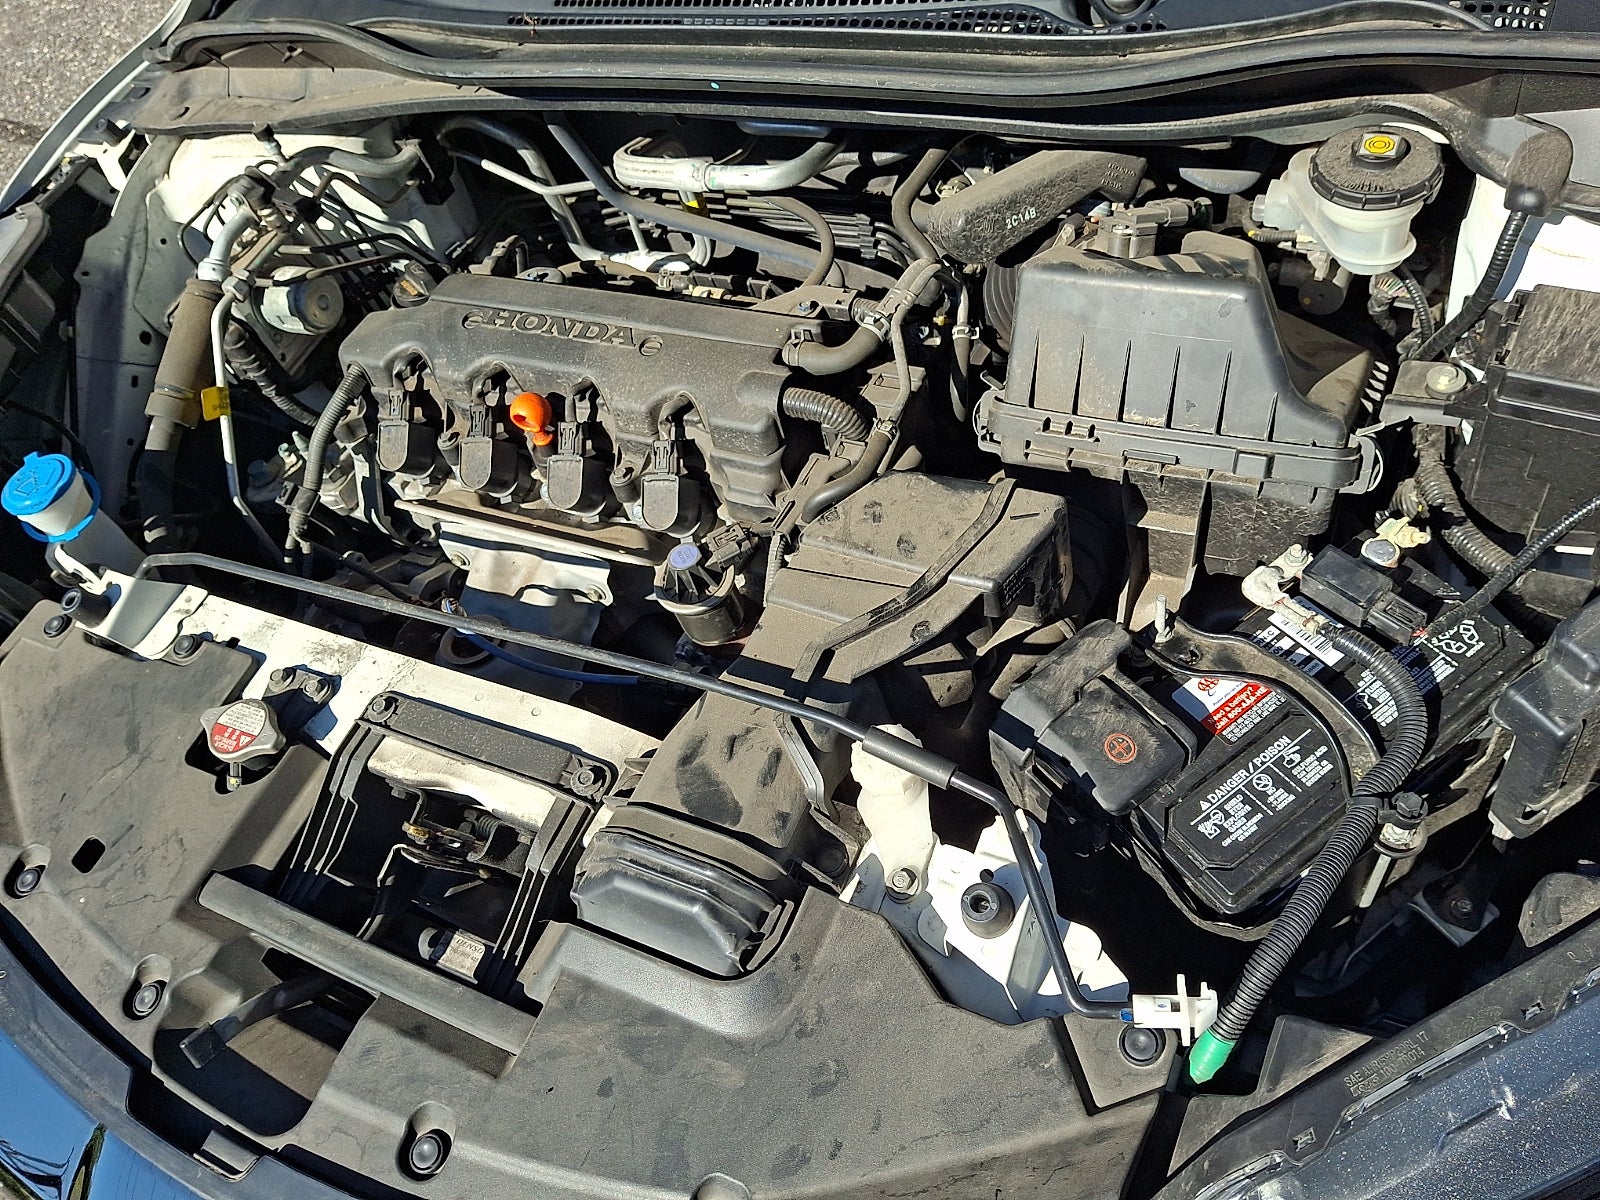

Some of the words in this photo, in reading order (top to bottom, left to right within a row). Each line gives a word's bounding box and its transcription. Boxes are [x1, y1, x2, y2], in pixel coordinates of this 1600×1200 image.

[480, 308, 637, 348] HONDA
[1208, 709, 1225, 722] Need
[1228, 686, 1253, 707] battery?
[1216, 717, 1229, 729] Call
[1207, 769, 1250, 803] DANGER
[1253, 735, 1292, 767] POISON
[456, 939, 484, 953] DENSO
[1344, 1070, 1363, 1086] SAE
[1416, 1030, 1428, 1043] 17
